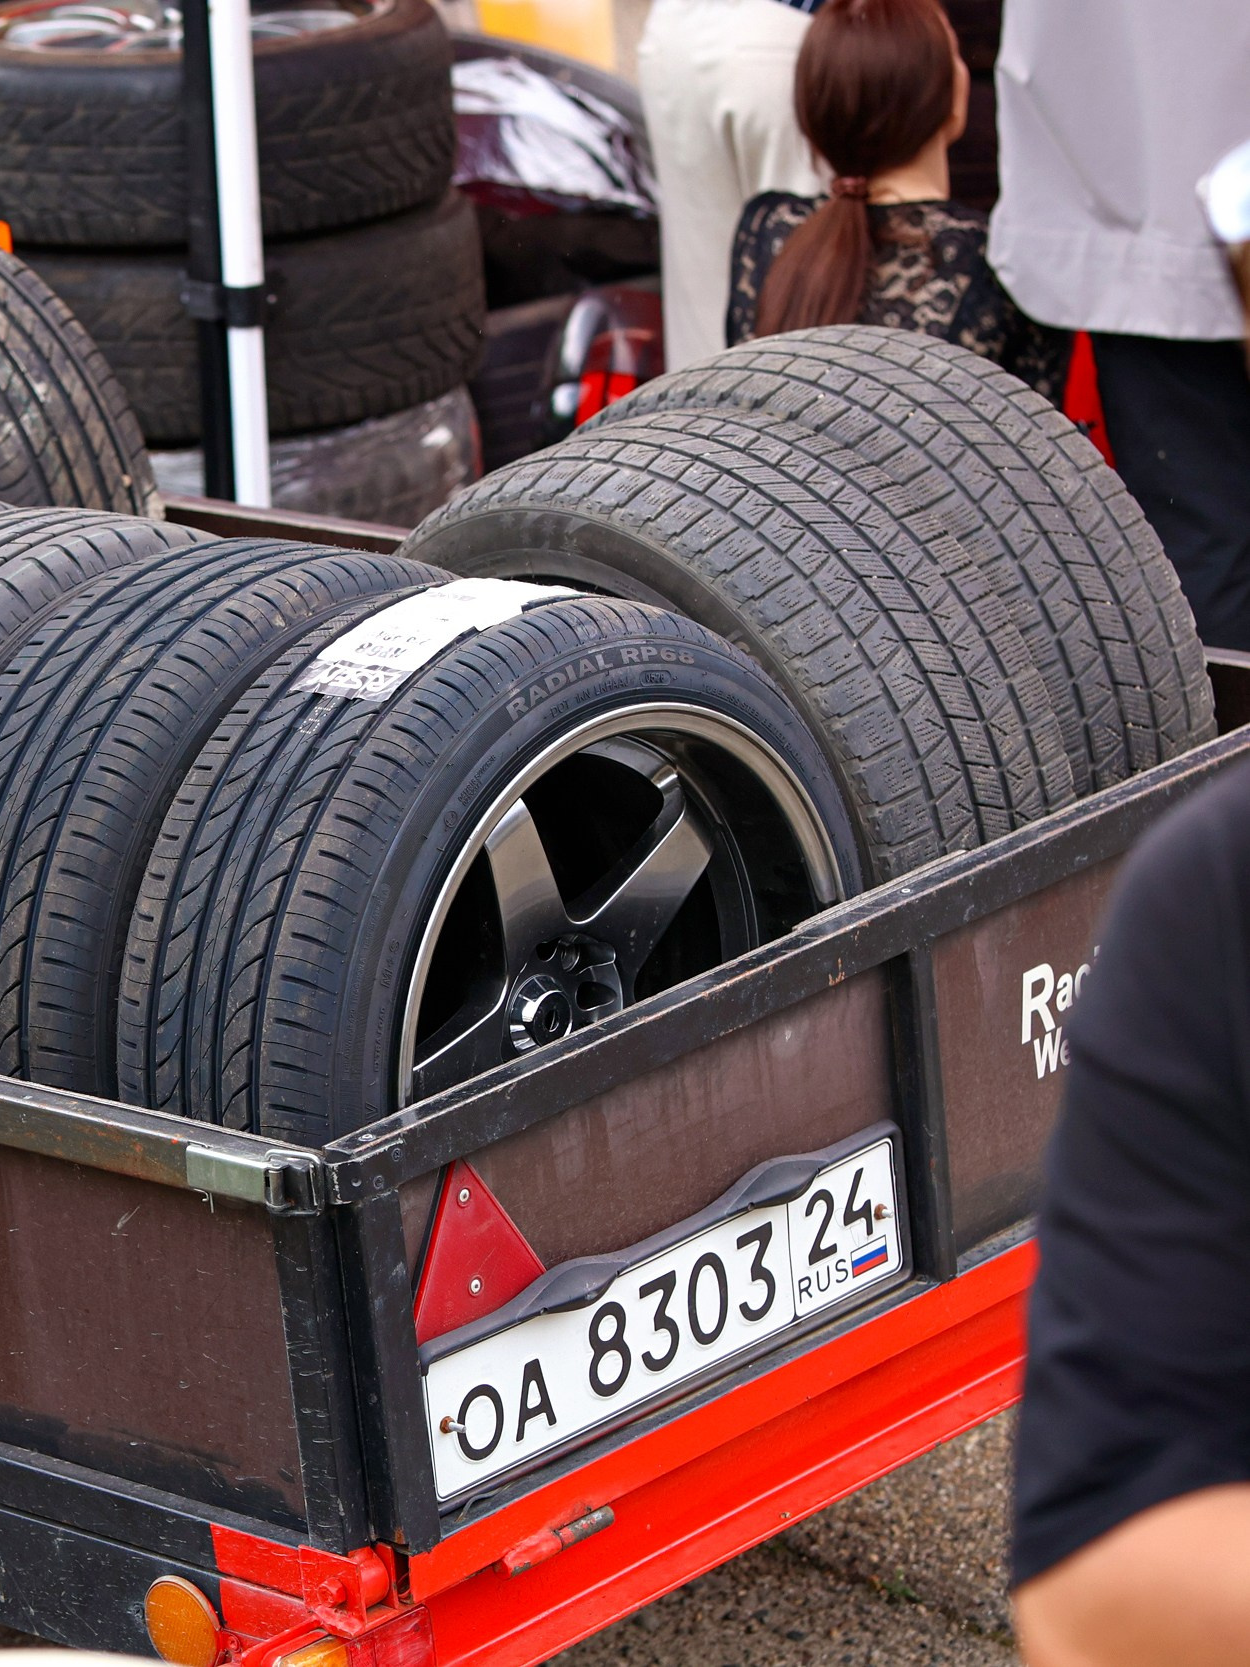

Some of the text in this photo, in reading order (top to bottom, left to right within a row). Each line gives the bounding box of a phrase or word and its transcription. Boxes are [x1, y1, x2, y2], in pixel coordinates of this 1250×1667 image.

[505, 653, 614, 722] RADIAL
[619, 646, 695, 666] RP68
[1021, 945, 1101, 1045] Rac
[1033, 1026, 1071, 1080] We
[456, 1167, 875, 1461] OA 8303 24
[797, 1258, 850, 1305] RUS
